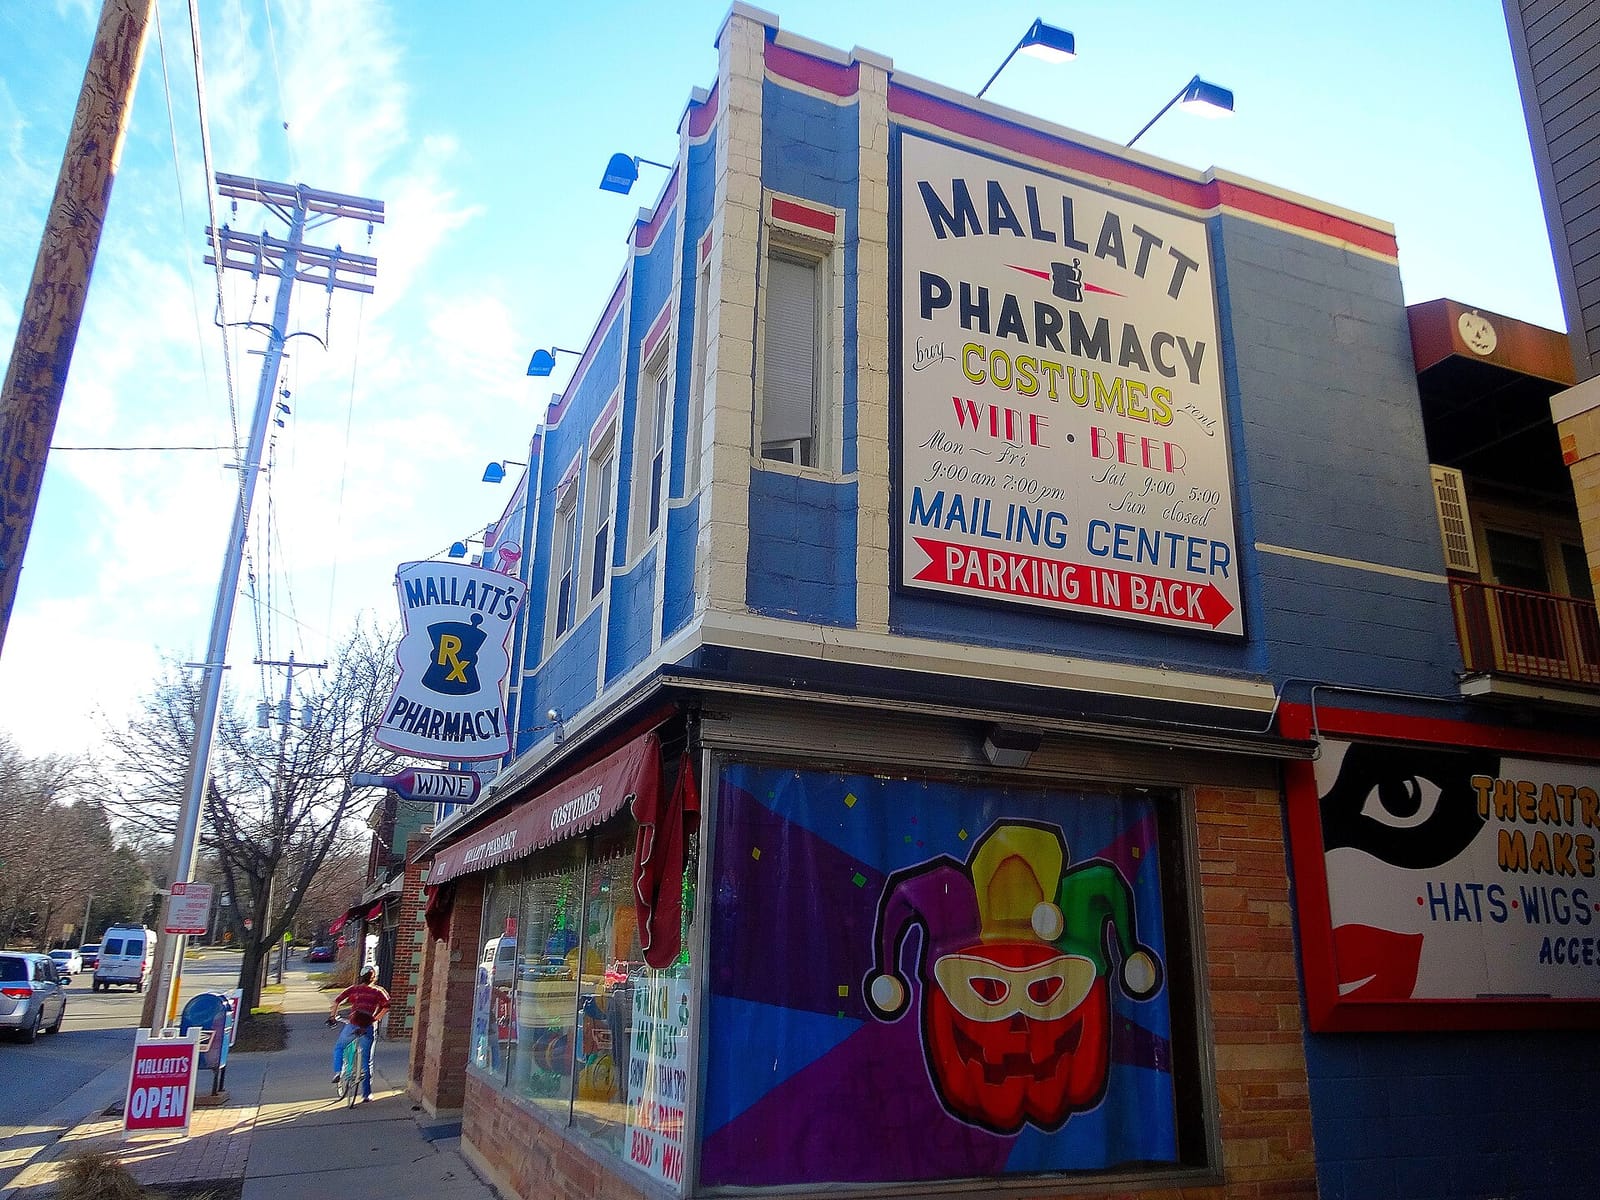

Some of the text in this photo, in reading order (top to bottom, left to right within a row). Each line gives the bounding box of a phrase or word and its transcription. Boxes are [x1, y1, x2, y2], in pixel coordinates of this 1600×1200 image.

[916, 178, 1200, 300] MALLATT
[919, 270, 1206, 384] PHARMACY
[912, 336, 1217, 437] buy COSTUMES rent
[918, 429, 965, 456] Mon
[995, 441, 1029, 467] Fri
[952, 396, 1187, 476] WINE BEER
[924, 460, 1065, 504] 9:00 am 7:00 pm
[1091, 464, 1220, 506] Sat 9:00 5:00
[1109, 491, 1217, 527] Sun closed
[909, 486, 1231, 579] MAILING CENTER
[404, 576, 520, 621] MALLATT'S
[945, 546, 1206, 621] PARKING IN BACK
[386, 695, 502, 743] PHARMACY
[416, 773, 470, 798] WINE
[550, 784, 603, 831] COSTUMES
[1426, 882, 1593, 926] HATS WIGS
[136, 1056, 189, 1075] MALLATT'S
[131, 1086, 187, 1119] OPEN
